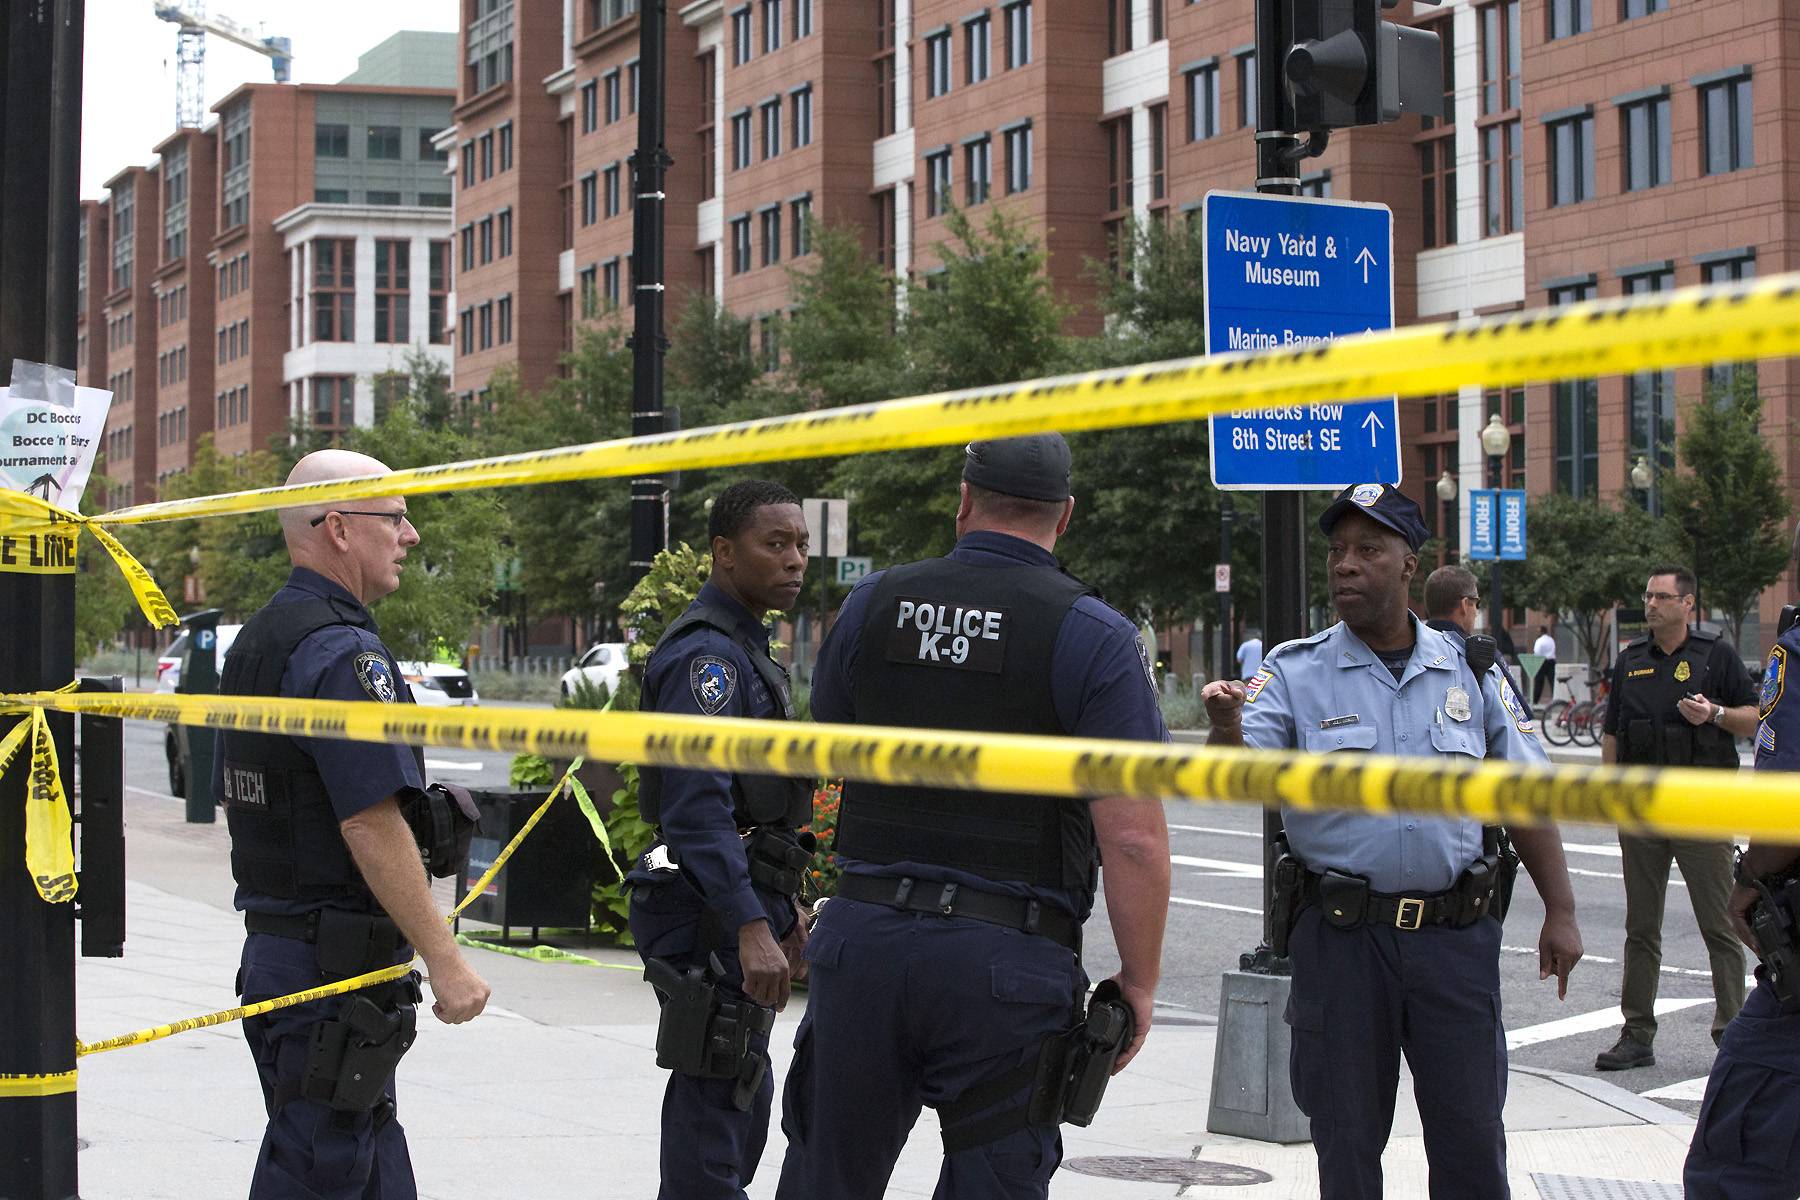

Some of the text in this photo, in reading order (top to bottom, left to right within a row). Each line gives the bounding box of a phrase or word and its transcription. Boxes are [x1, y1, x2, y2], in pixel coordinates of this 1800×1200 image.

[1226, 229, 1337, 258] Navy Yard &
[1245, 261, 1320, 287] Museum
[1228, 327, 1345, 350] Marine Barra
[27, 412, 47, 424] DC
[1310, 400, 1343, 421] Row
[12, 435, 54, 447] Bocce
[1232, 427, 1341, 451] 8th Street SE
[0, 456, 67, 467] urnament
[30, 534, 75, 567] LINE
[841, 561, 855, 581] P
[897, 601, 1002, 640] POLICE
[201, 630, 214, 649] P
[918, 632, 970, 664] K-9
[234, 769, 266, 805] TECH
